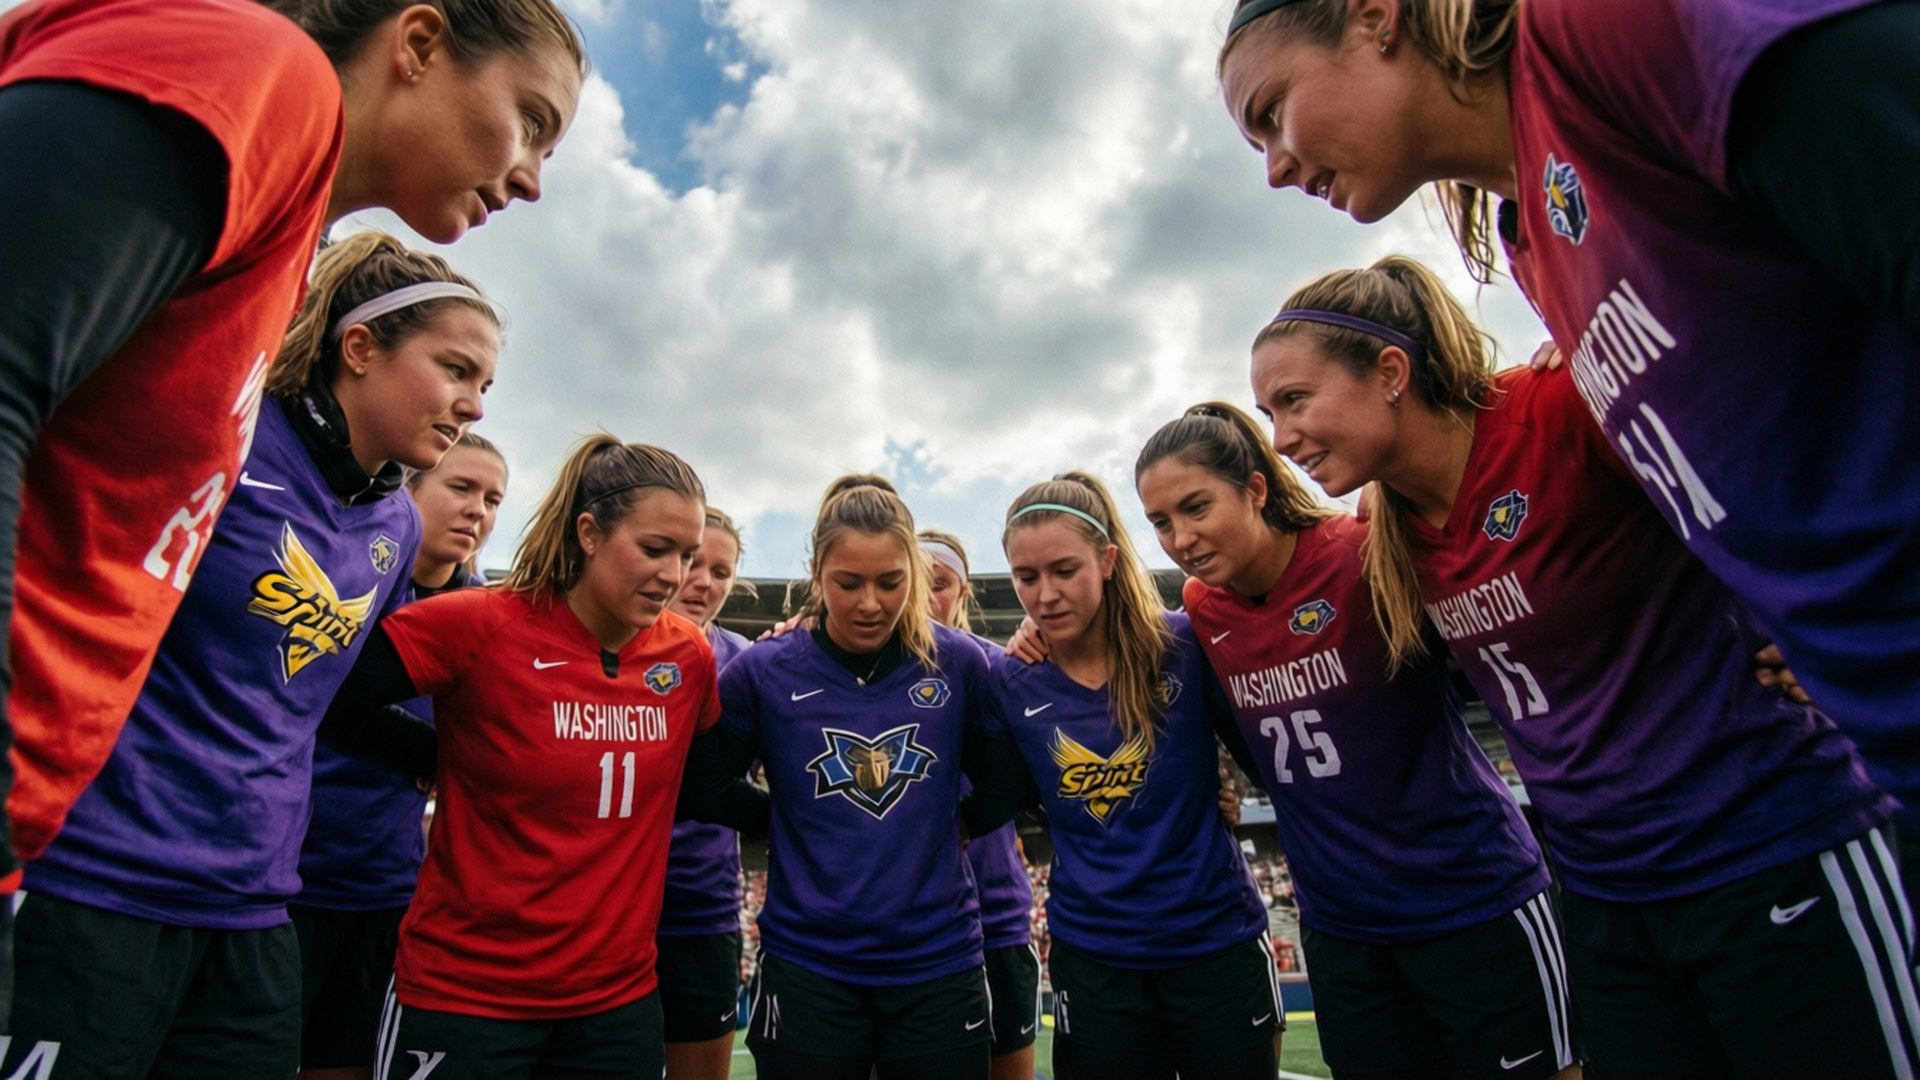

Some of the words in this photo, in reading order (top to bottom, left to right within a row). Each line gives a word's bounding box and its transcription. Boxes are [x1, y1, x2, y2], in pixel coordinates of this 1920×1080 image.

[1229, 648, 1348, 708] WASHINGTON
[1478, 642, 1549, 721] 15
[553, 702, 667, 742] WASHINGTON
[1260, 709, 1341, 784] 25
[598, 752, 635, 819] 11
